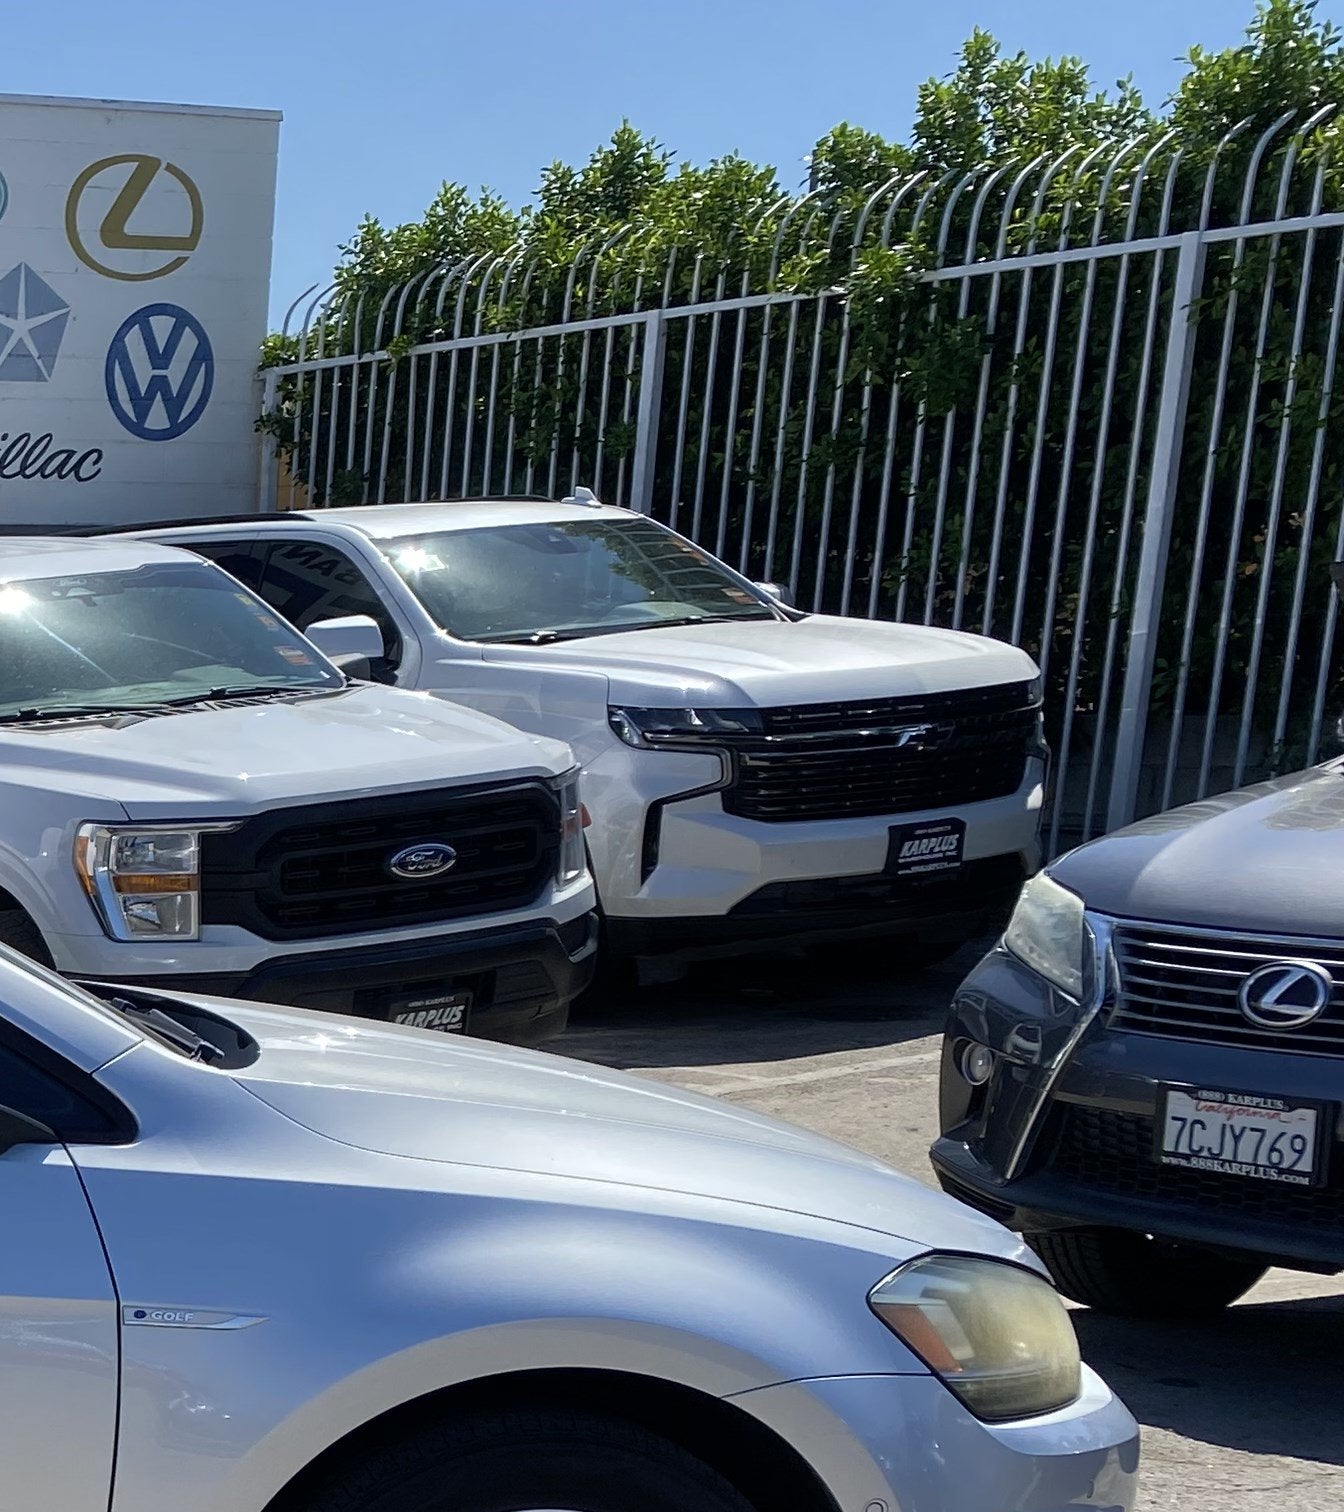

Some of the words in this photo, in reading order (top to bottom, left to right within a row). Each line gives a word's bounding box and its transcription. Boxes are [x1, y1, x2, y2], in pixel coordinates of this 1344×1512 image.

[899, 833, 960, 858] KARPLUS
[405, 850, 445, 871] Ford
[1227, 1092, 1285, 1110] KARPLUS
[1170, 1115, 1308, 1170] 7CJY769
